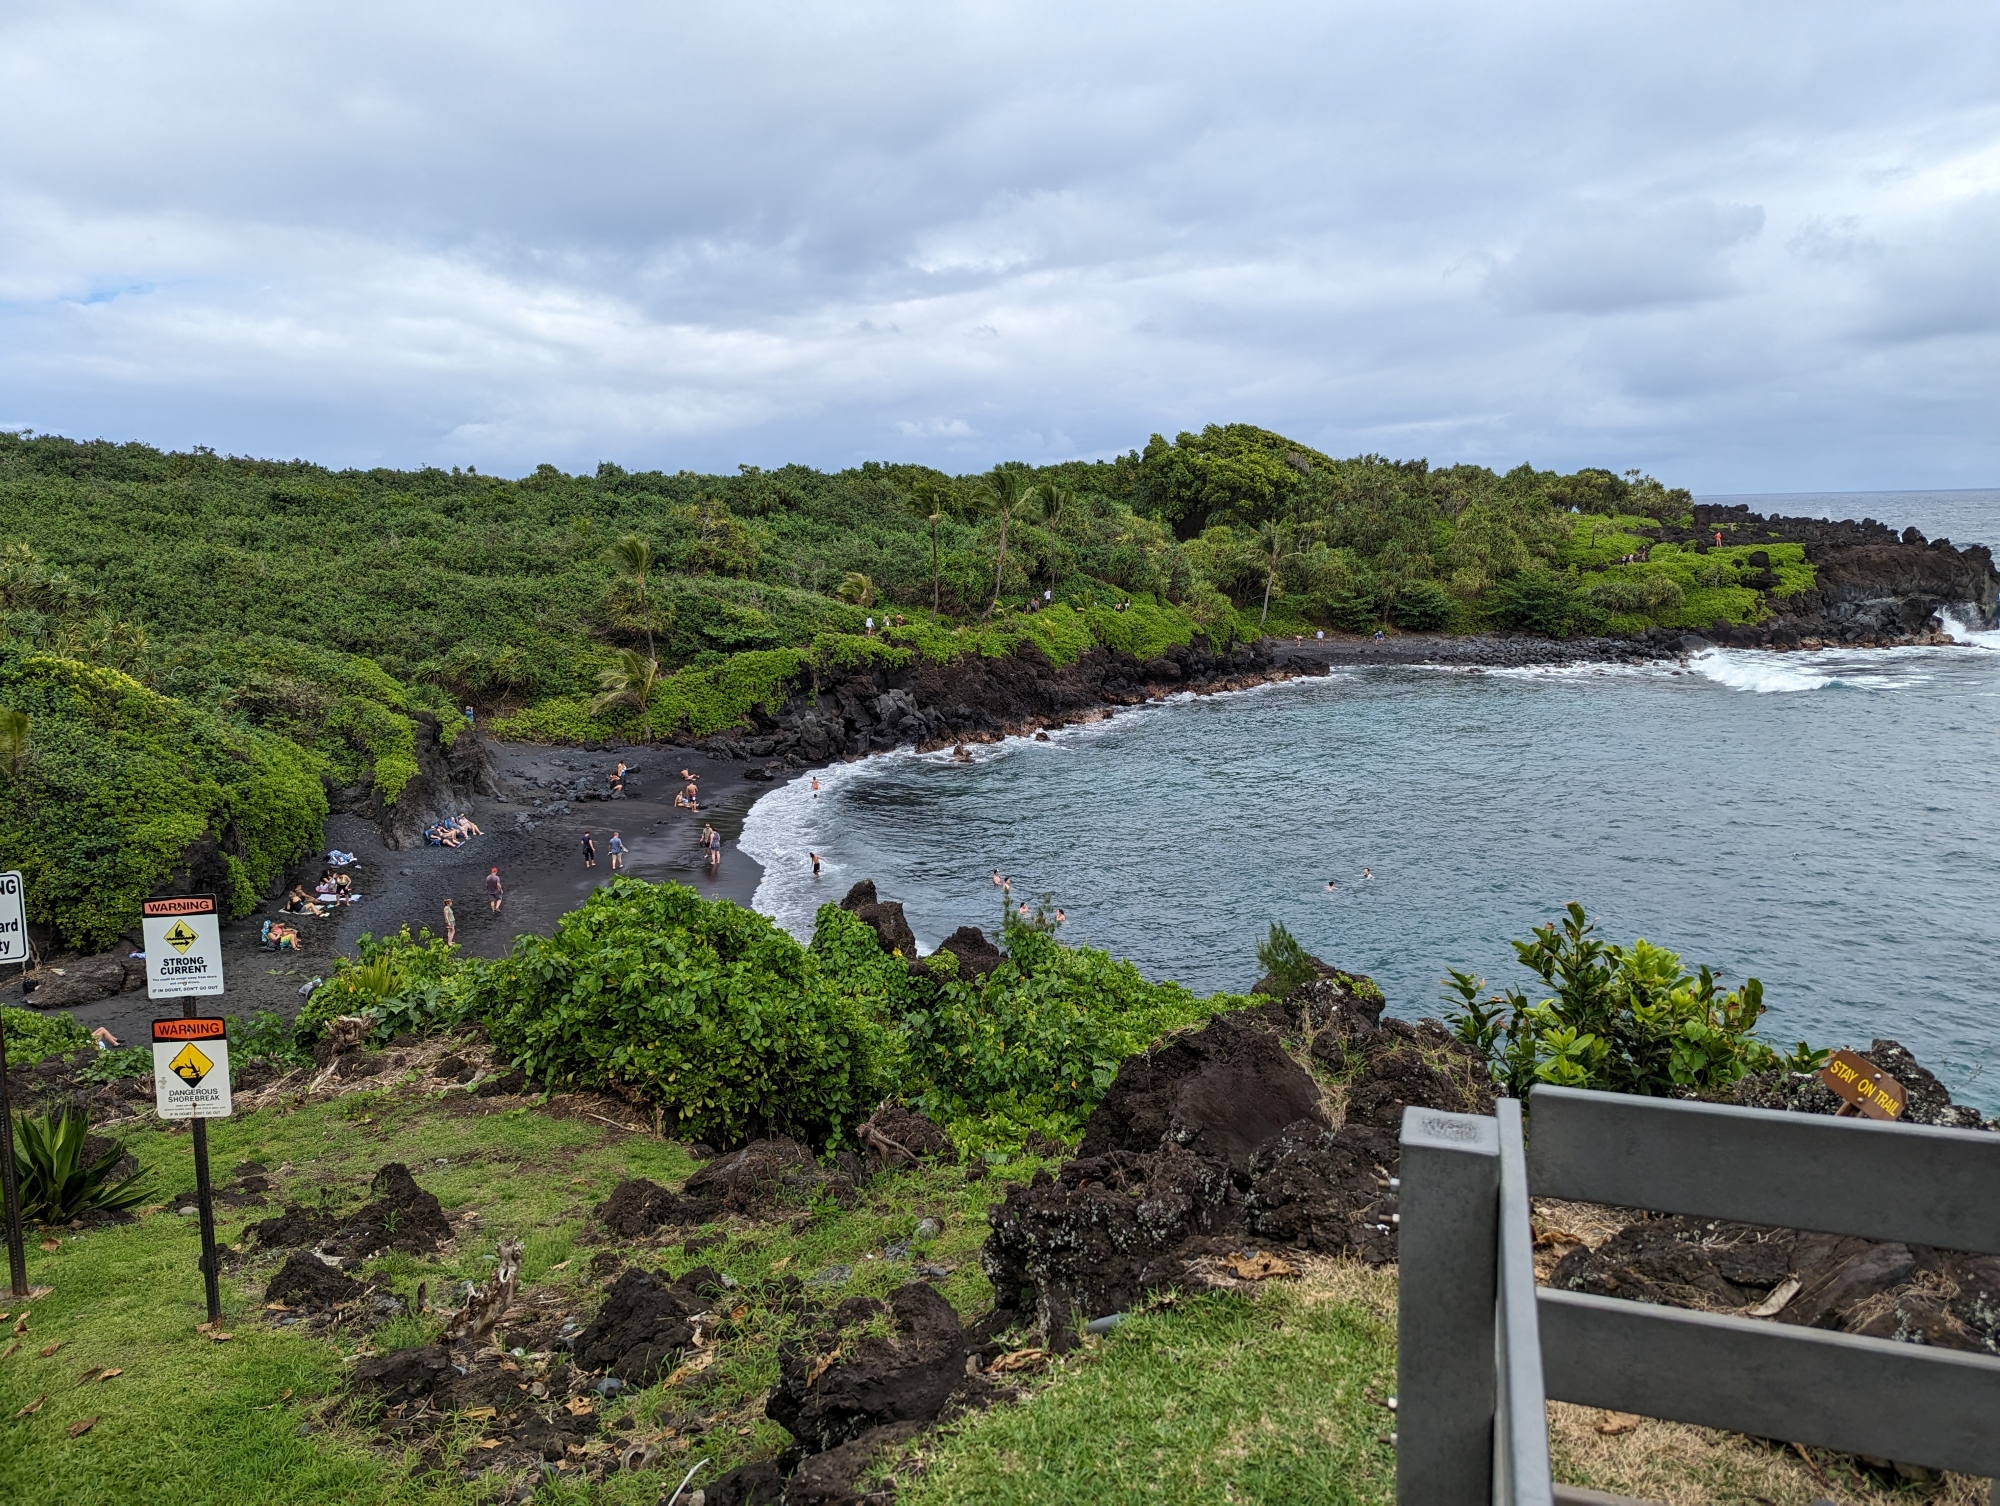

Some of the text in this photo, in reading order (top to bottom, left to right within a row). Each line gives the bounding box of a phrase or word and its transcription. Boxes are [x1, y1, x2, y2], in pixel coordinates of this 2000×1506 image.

[148, 901, 209, 912] WARNING
[163, 957, 204, 966] STRONG
[160, 965, 208, 975] CURRENT
[158, 1022, 219, 1035] WARNING
[169, 1088, 218, 1096] DANGEROUS
[1830, 1060, 1899, 1117] STAY ON TRAIL
[168, 1095, 220, 1103] SHOREBREAK
